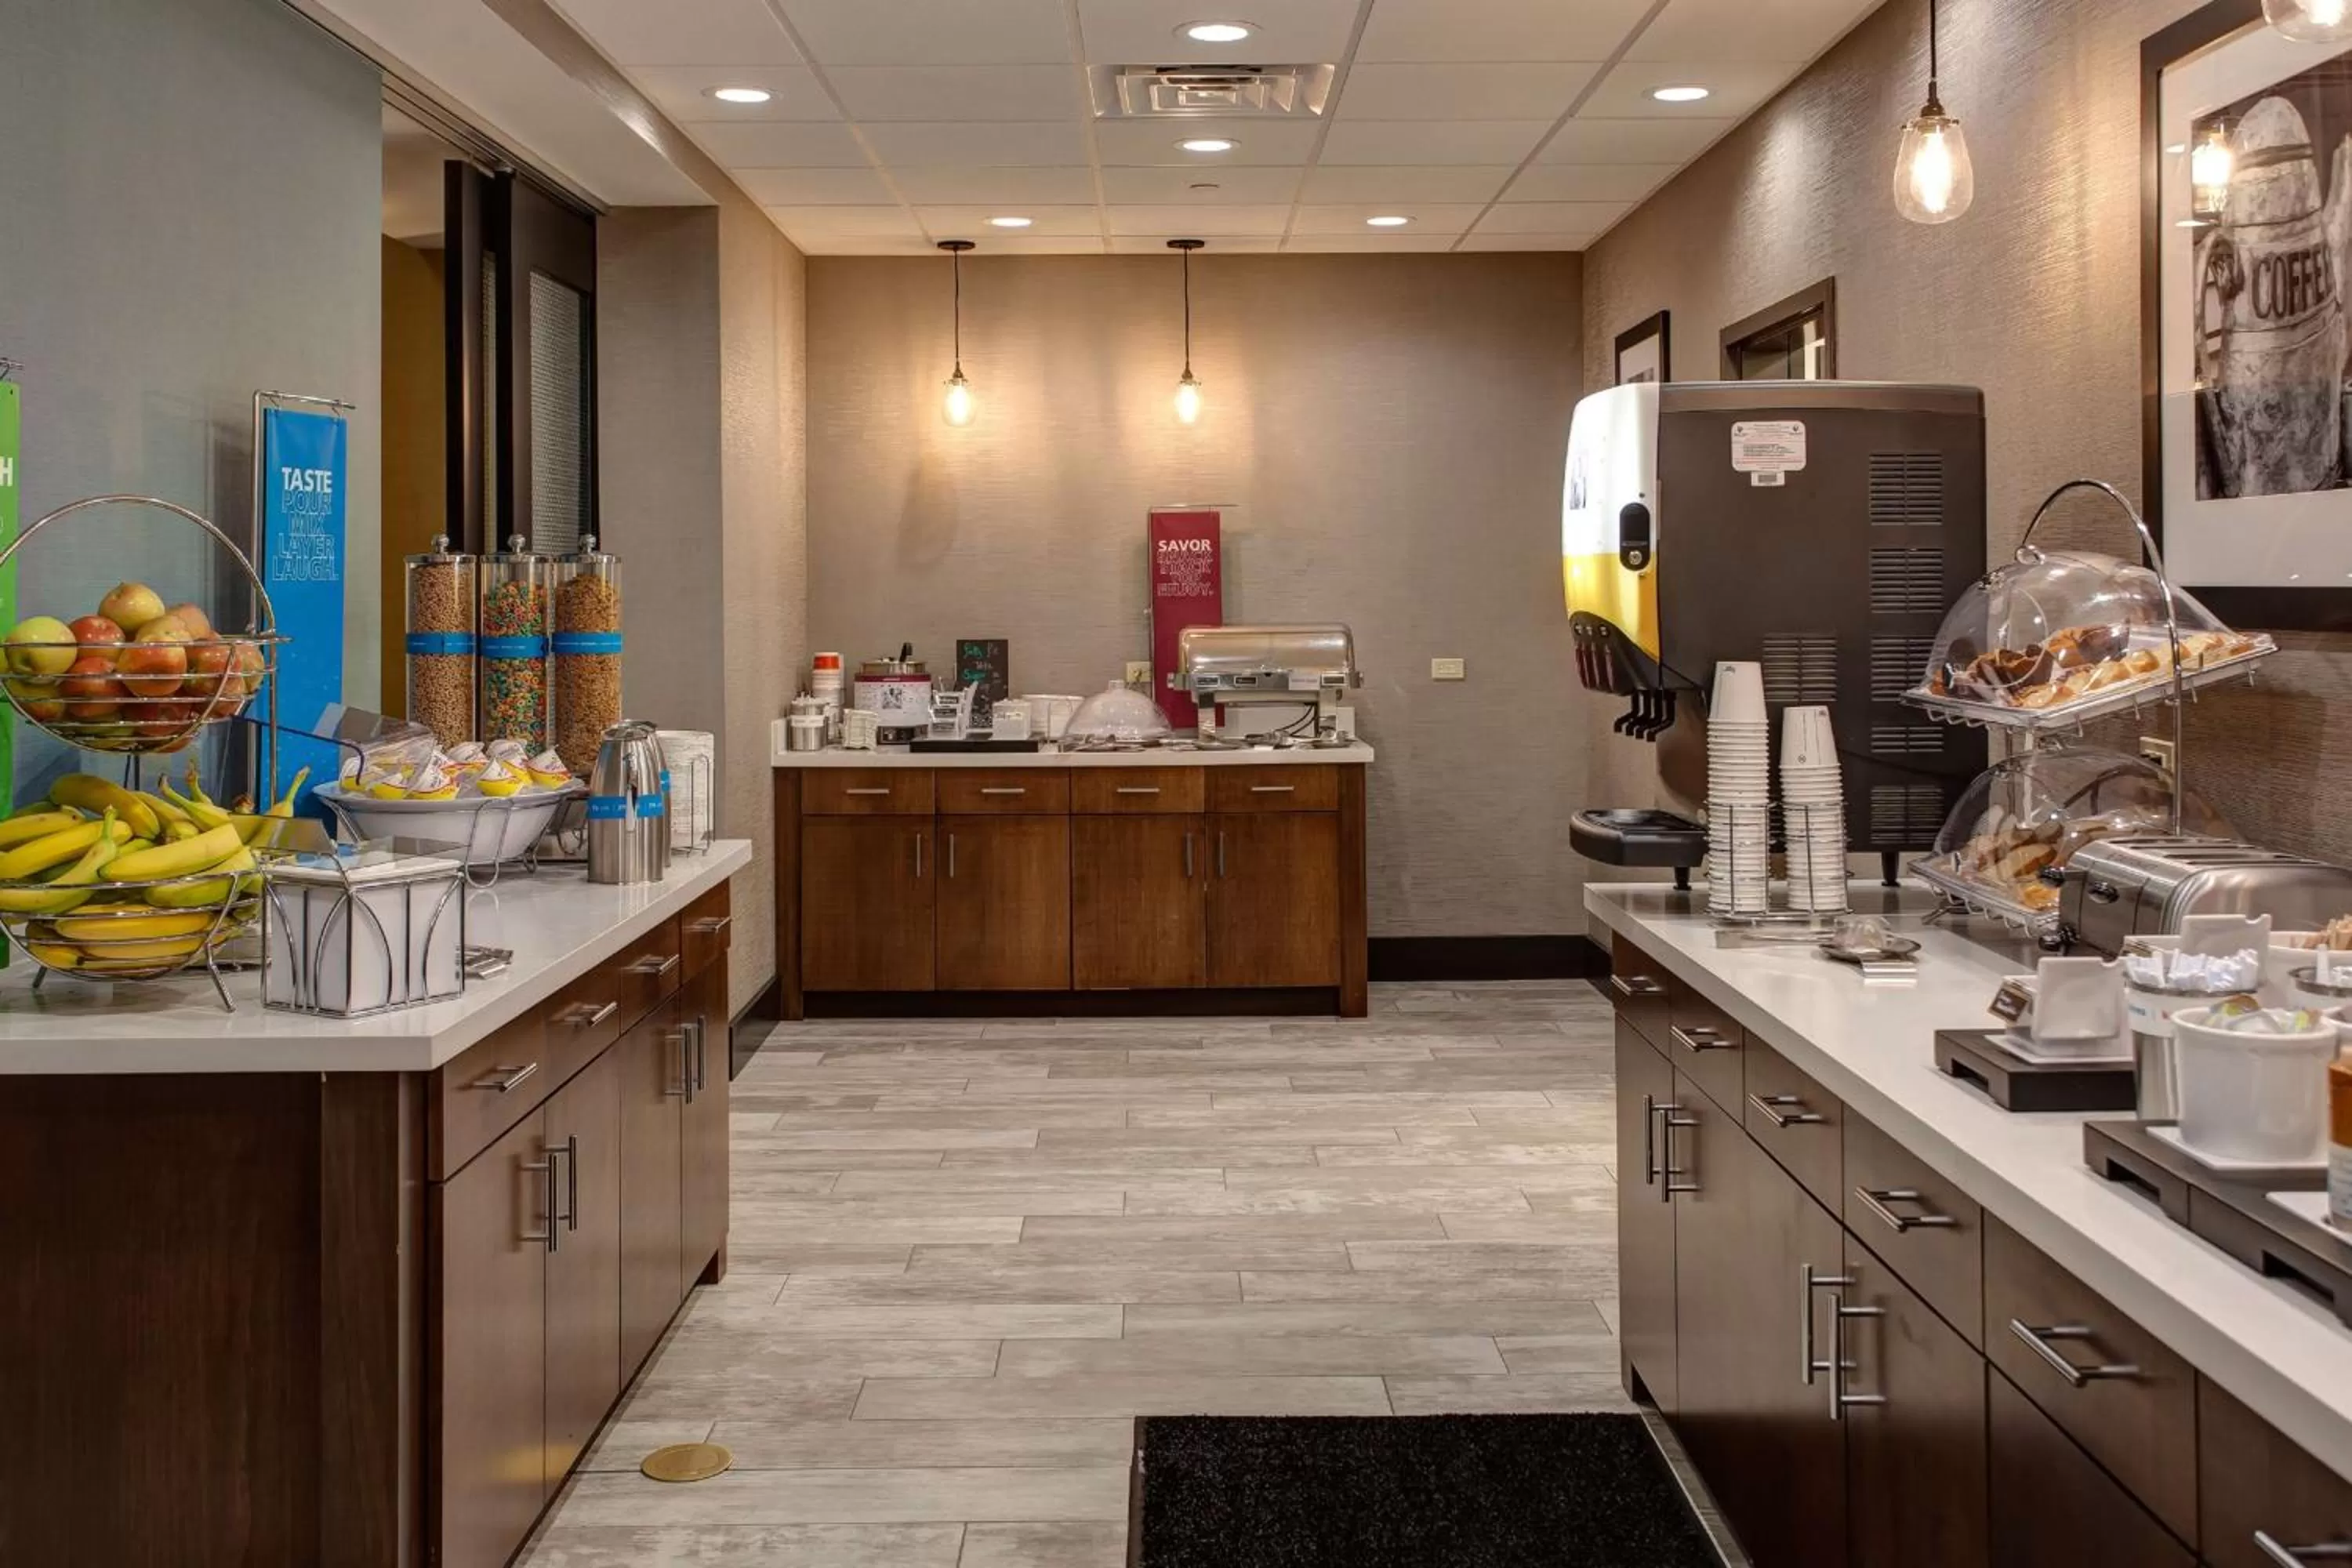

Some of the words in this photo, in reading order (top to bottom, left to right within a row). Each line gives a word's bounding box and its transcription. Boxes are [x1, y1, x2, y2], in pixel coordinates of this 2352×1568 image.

[281, 466, 333, 492] TASTE
[281, 490, 332, 514] POUR
[288, 513, 326, 536] MIX
[278, 533, 336, 559] LAYER
[1158, 539, 1211, 551] SAVOR
